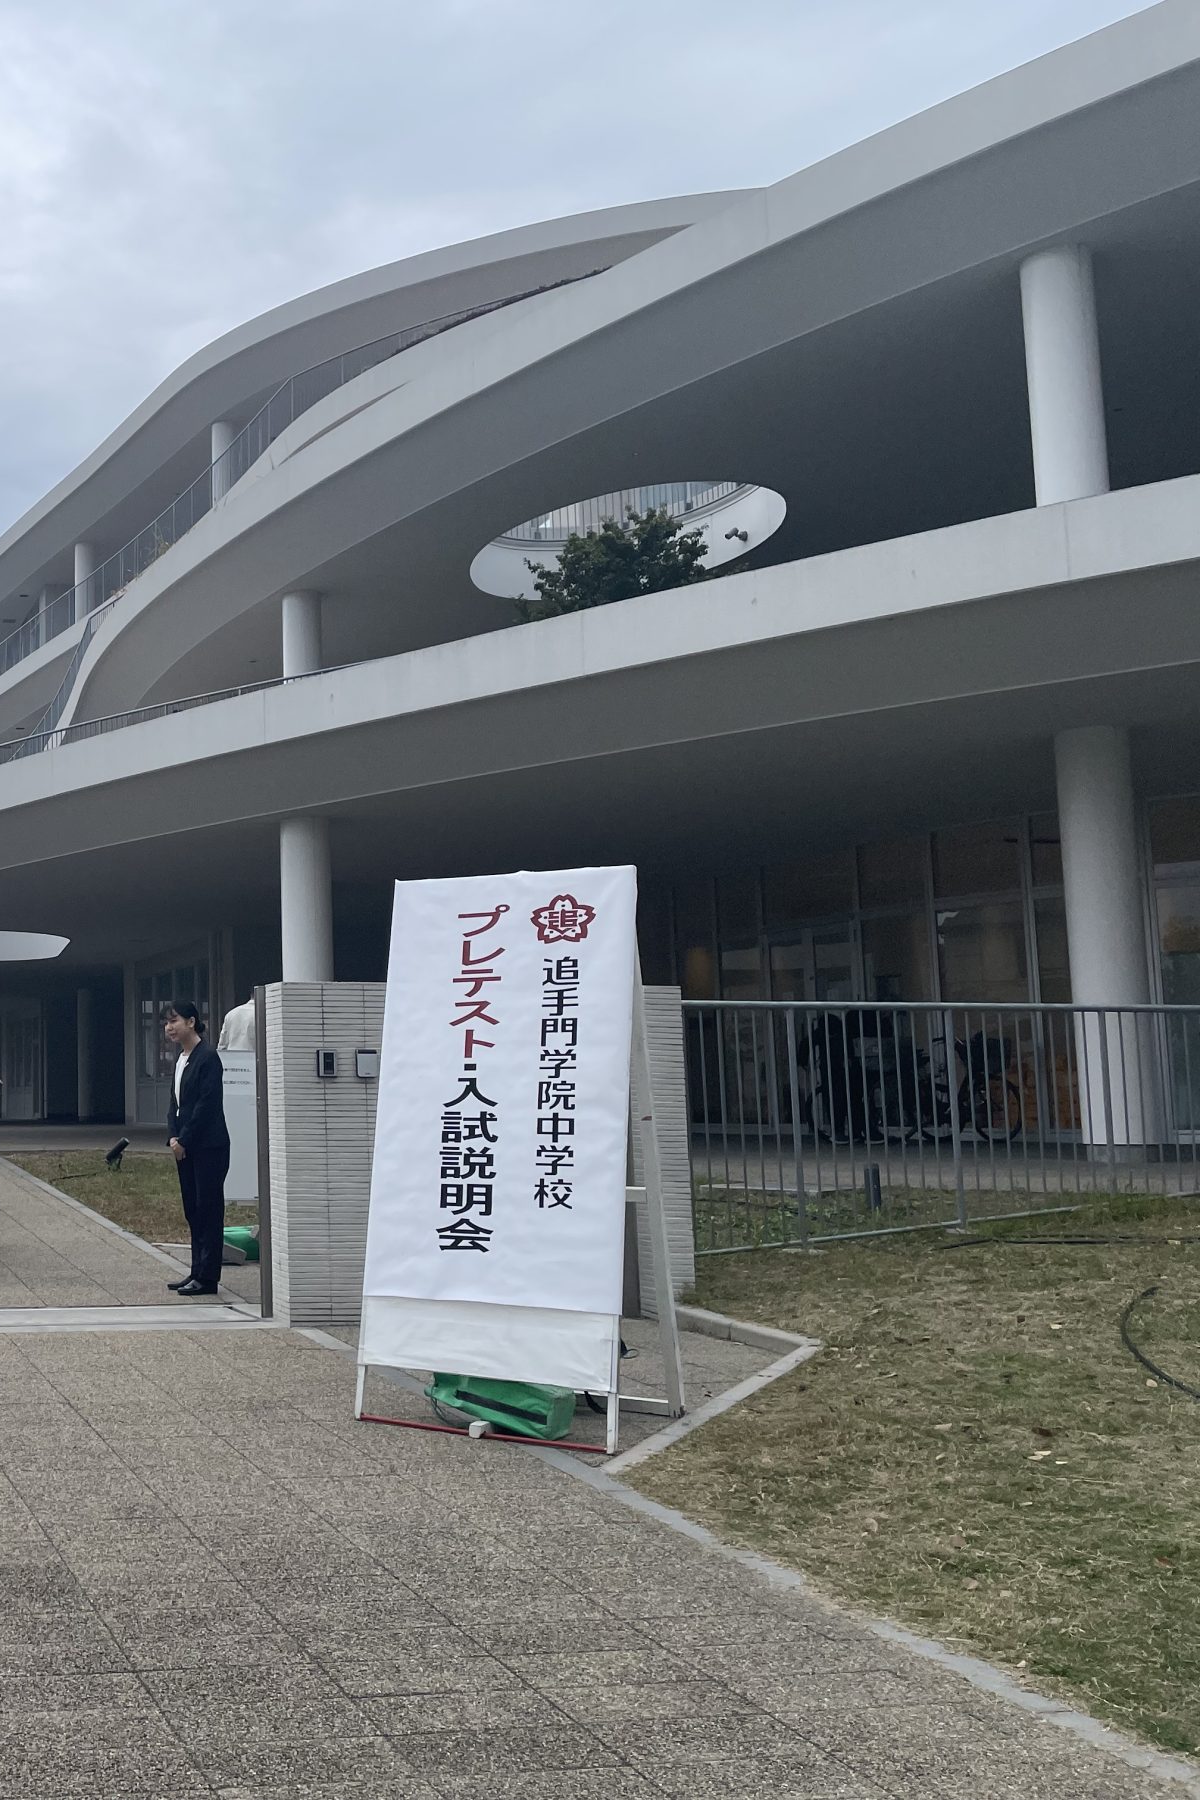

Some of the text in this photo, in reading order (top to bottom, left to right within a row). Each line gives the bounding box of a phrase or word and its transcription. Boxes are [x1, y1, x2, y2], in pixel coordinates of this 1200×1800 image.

[436, 904, 511, 1253] プレテスト・入試説明会
[534, 956, 580, 1210] 追手門学院中学校
